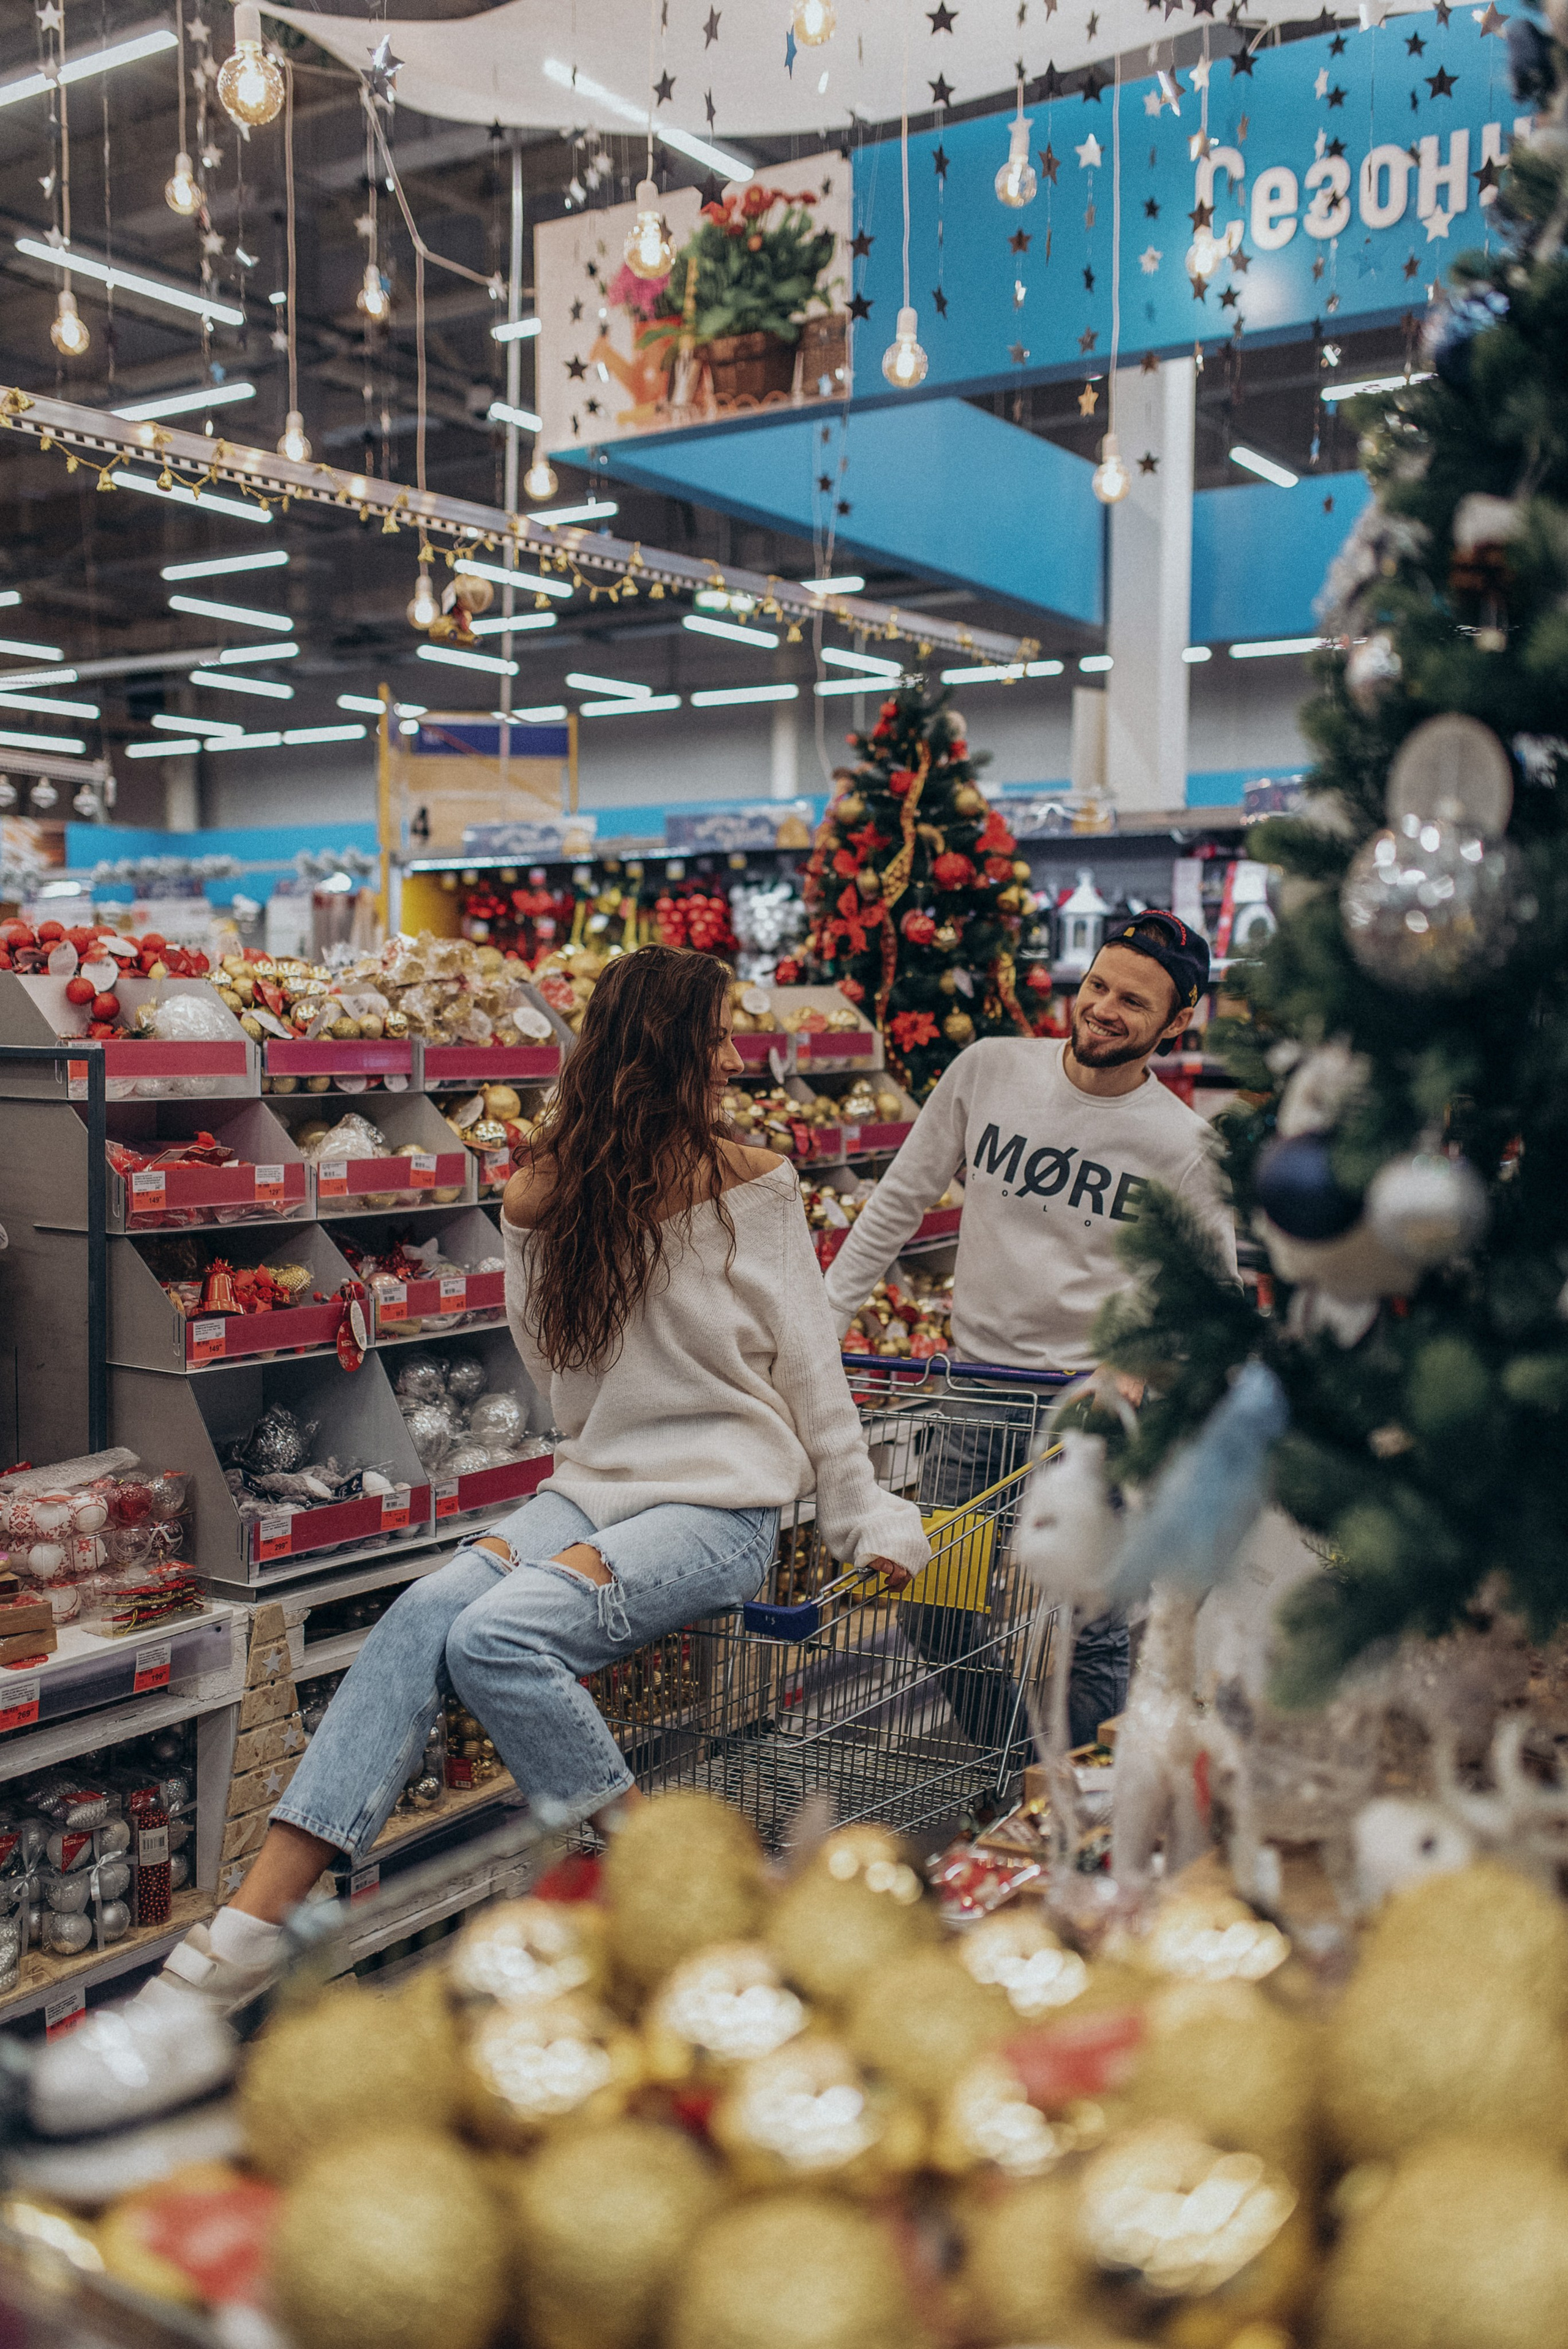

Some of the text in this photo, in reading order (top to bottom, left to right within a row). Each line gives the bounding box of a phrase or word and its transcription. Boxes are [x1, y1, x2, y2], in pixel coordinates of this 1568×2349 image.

[973, 1123, 1149, 1224] MØRE
[152, 1673, 163, 1681] 199
[17, 1710, 31, 1719] 269
